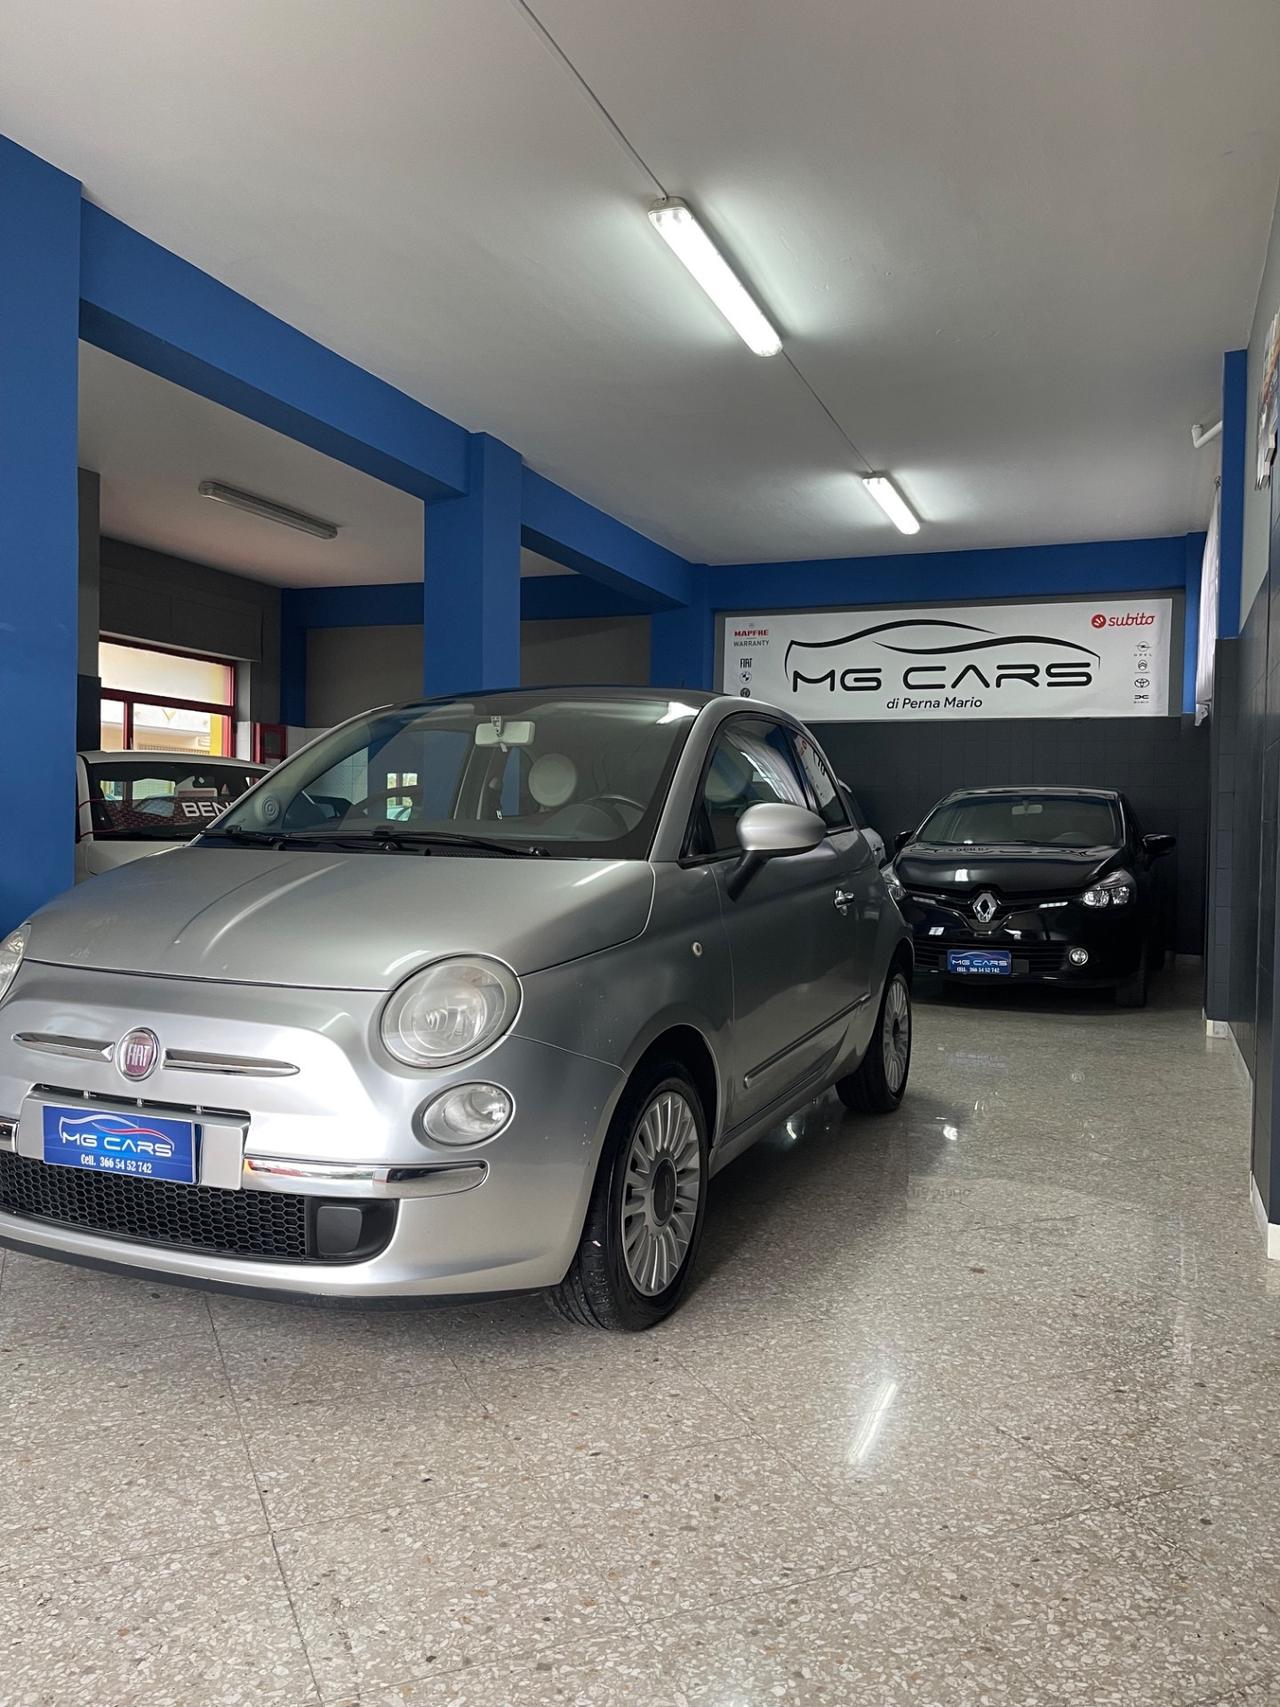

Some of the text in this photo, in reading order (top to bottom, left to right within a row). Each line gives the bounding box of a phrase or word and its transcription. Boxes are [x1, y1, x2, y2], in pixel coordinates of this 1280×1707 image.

[1108, 612, 1155, 627] subito
[740, 658, 752, 668] FIAT
[793, 662, 1092, 692] MG CARS
[886, 696, 983, 709] di Perna Mario
[181, 801, 234, 817] BEN
[127, 1043, 151, 1067] FIAT
[62, 1132, 172, 1157] MG CARS
[100, 1156, 114, 1168] 366
[115, 1159, 125, 1170] 54
[126, 1161, 136, 1172] 52
[137, 1163, 152, 1174] 742
